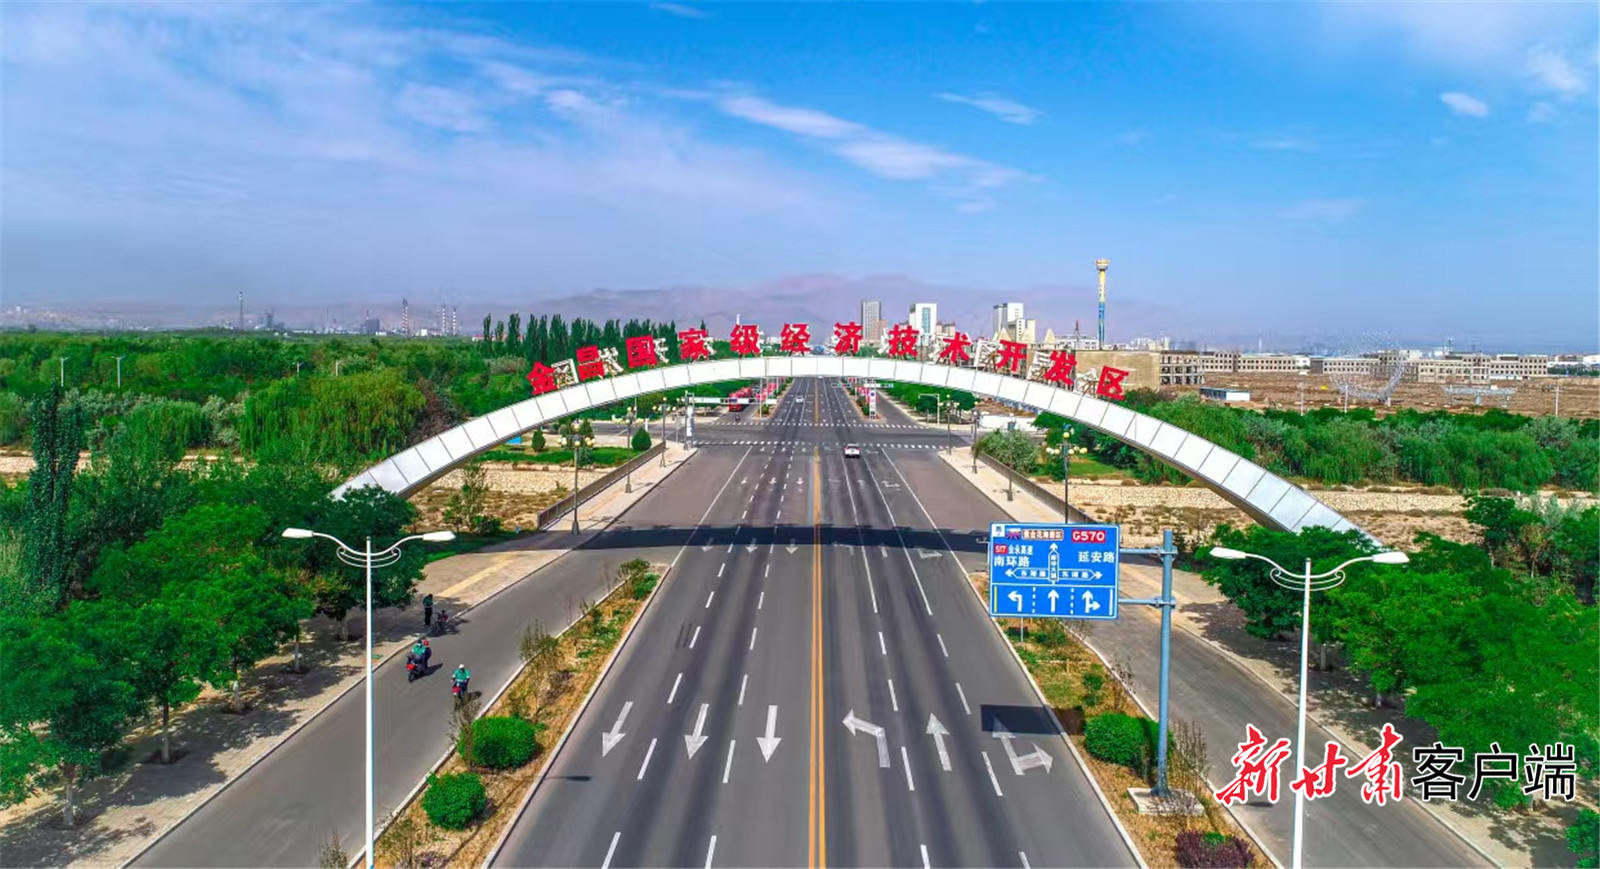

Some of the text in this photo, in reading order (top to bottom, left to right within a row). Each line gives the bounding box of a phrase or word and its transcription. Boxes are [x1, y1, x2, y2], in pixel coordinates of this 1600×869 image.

[528, 322, 1128, 400] 金昌国家级经济技术开发区
[1072, 531, 1105, 542] G570
[994, 556, 1030, 567] 南环路
[1079, 551, 1115, 563] 延安路
